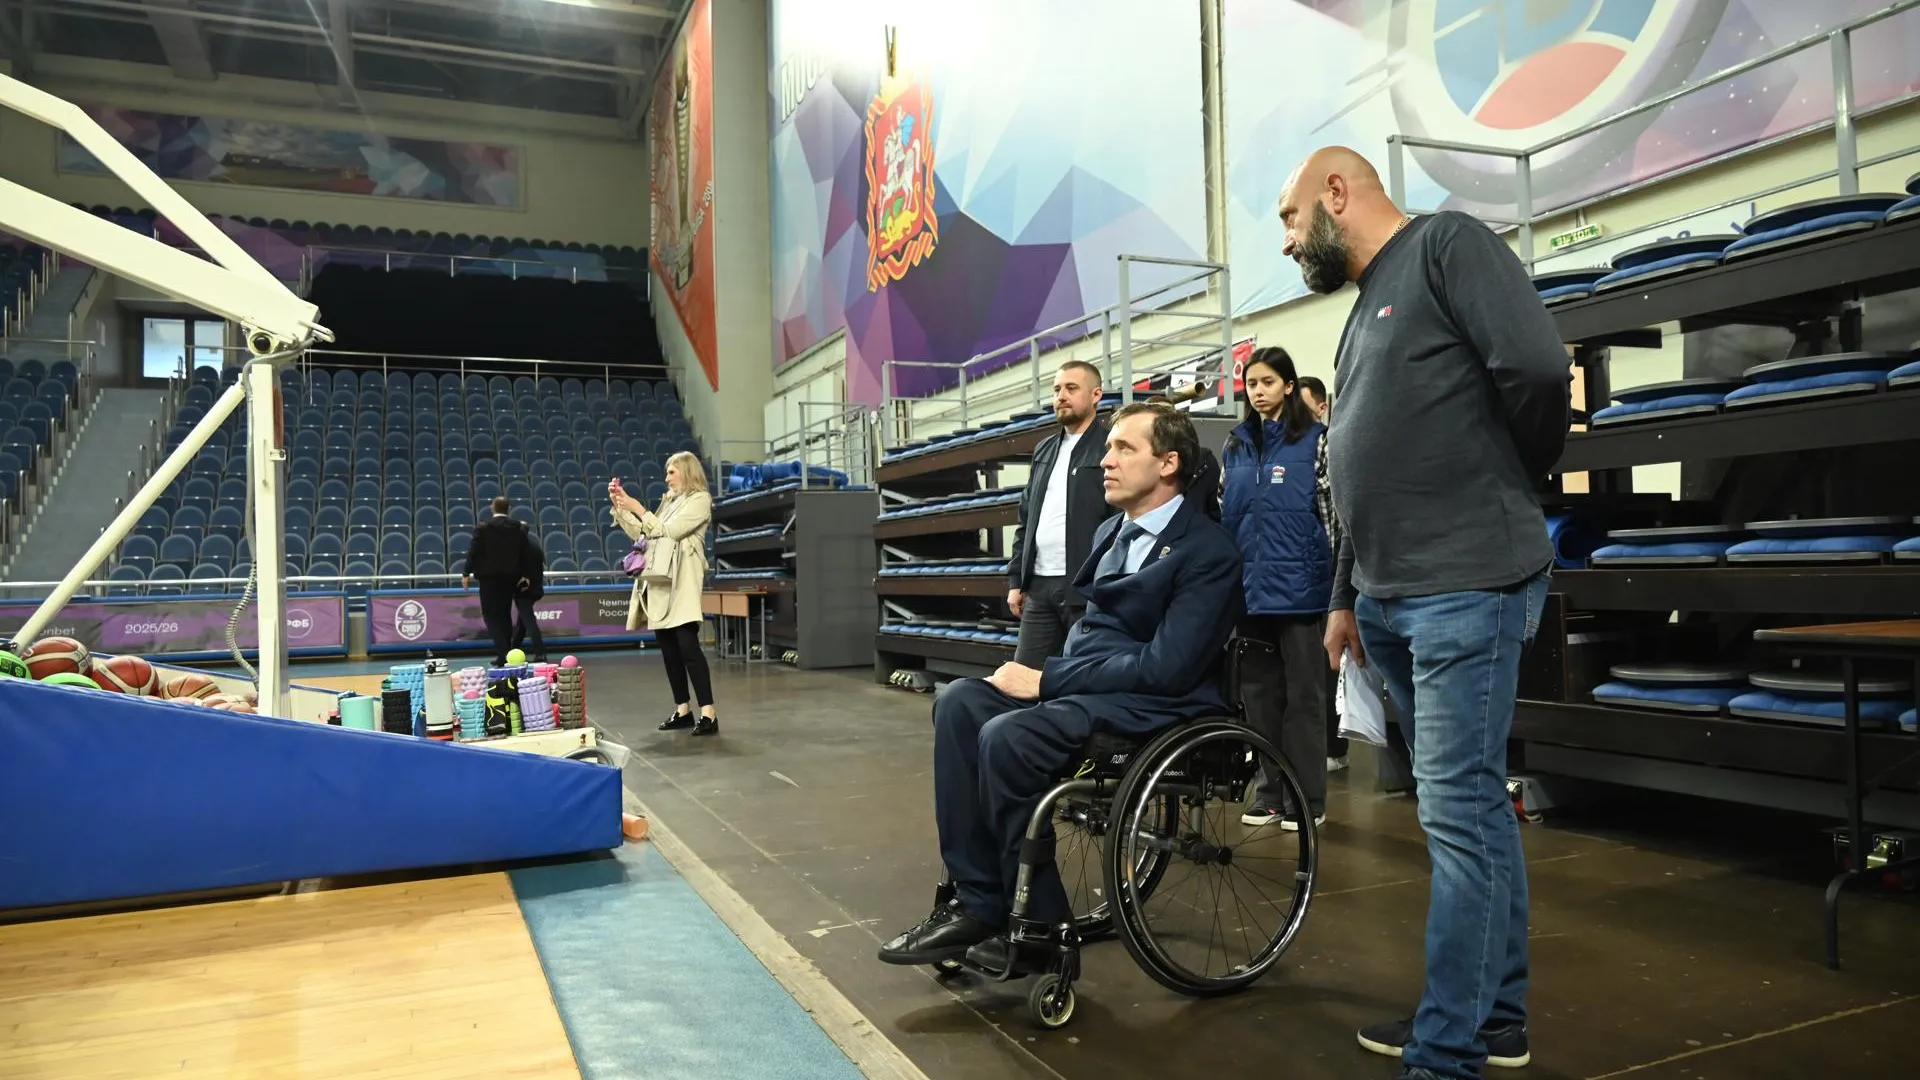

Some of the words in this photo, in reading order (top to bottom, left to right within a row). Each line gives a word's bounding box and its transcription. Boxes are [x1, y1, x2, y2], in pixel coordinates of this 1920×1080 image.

[598, 598, 630, 607] Чемпи
[533, 610, 563, 620] NBET
[599, 609, 629, 617] Росси
[40, 626, 76, 637] onbet
[124, 622, 179, 634] 2025/26
